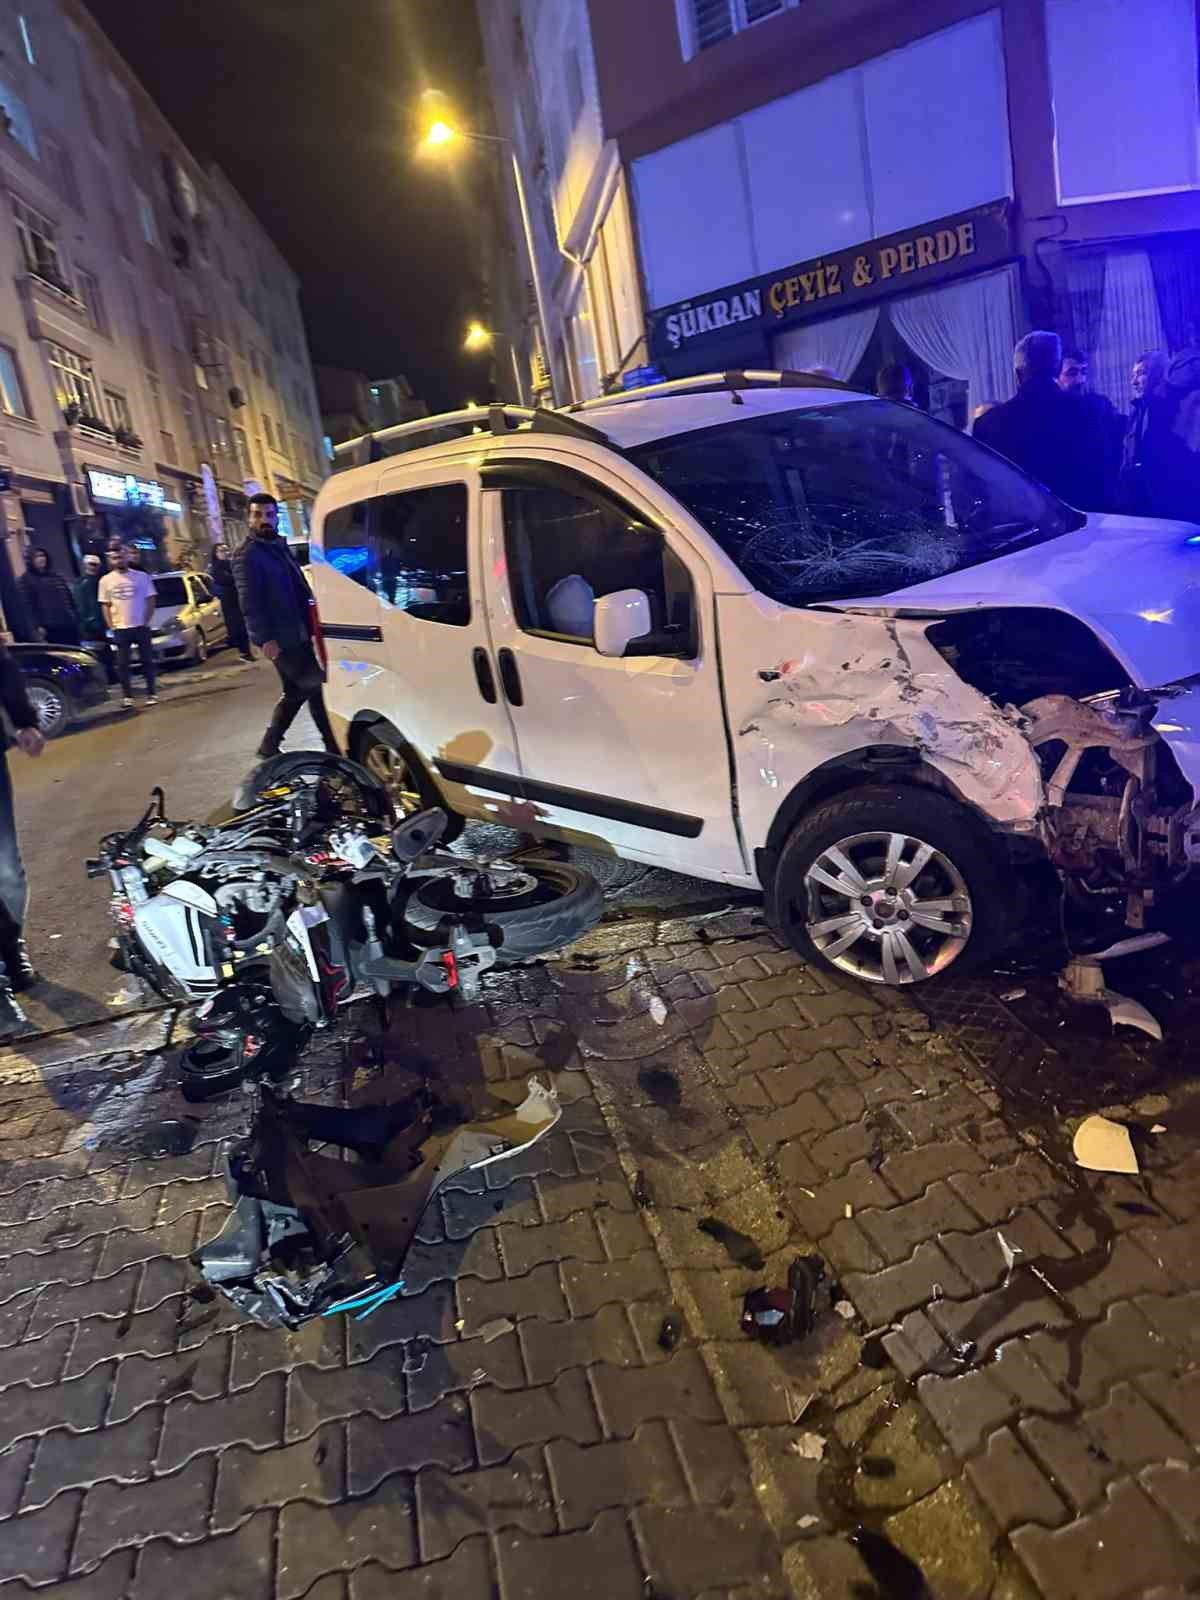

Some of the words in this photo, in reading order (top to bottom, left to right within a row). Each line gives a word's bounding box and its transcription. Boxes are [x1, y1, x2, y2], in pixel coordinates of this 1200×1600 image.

[665, 289, 762, 349] ŞÜKRAN
[769, 261, 842, 318] ÇEYİZ
[852, 256, 873, 287] &
[880, 222, 975, 279] PERDE
